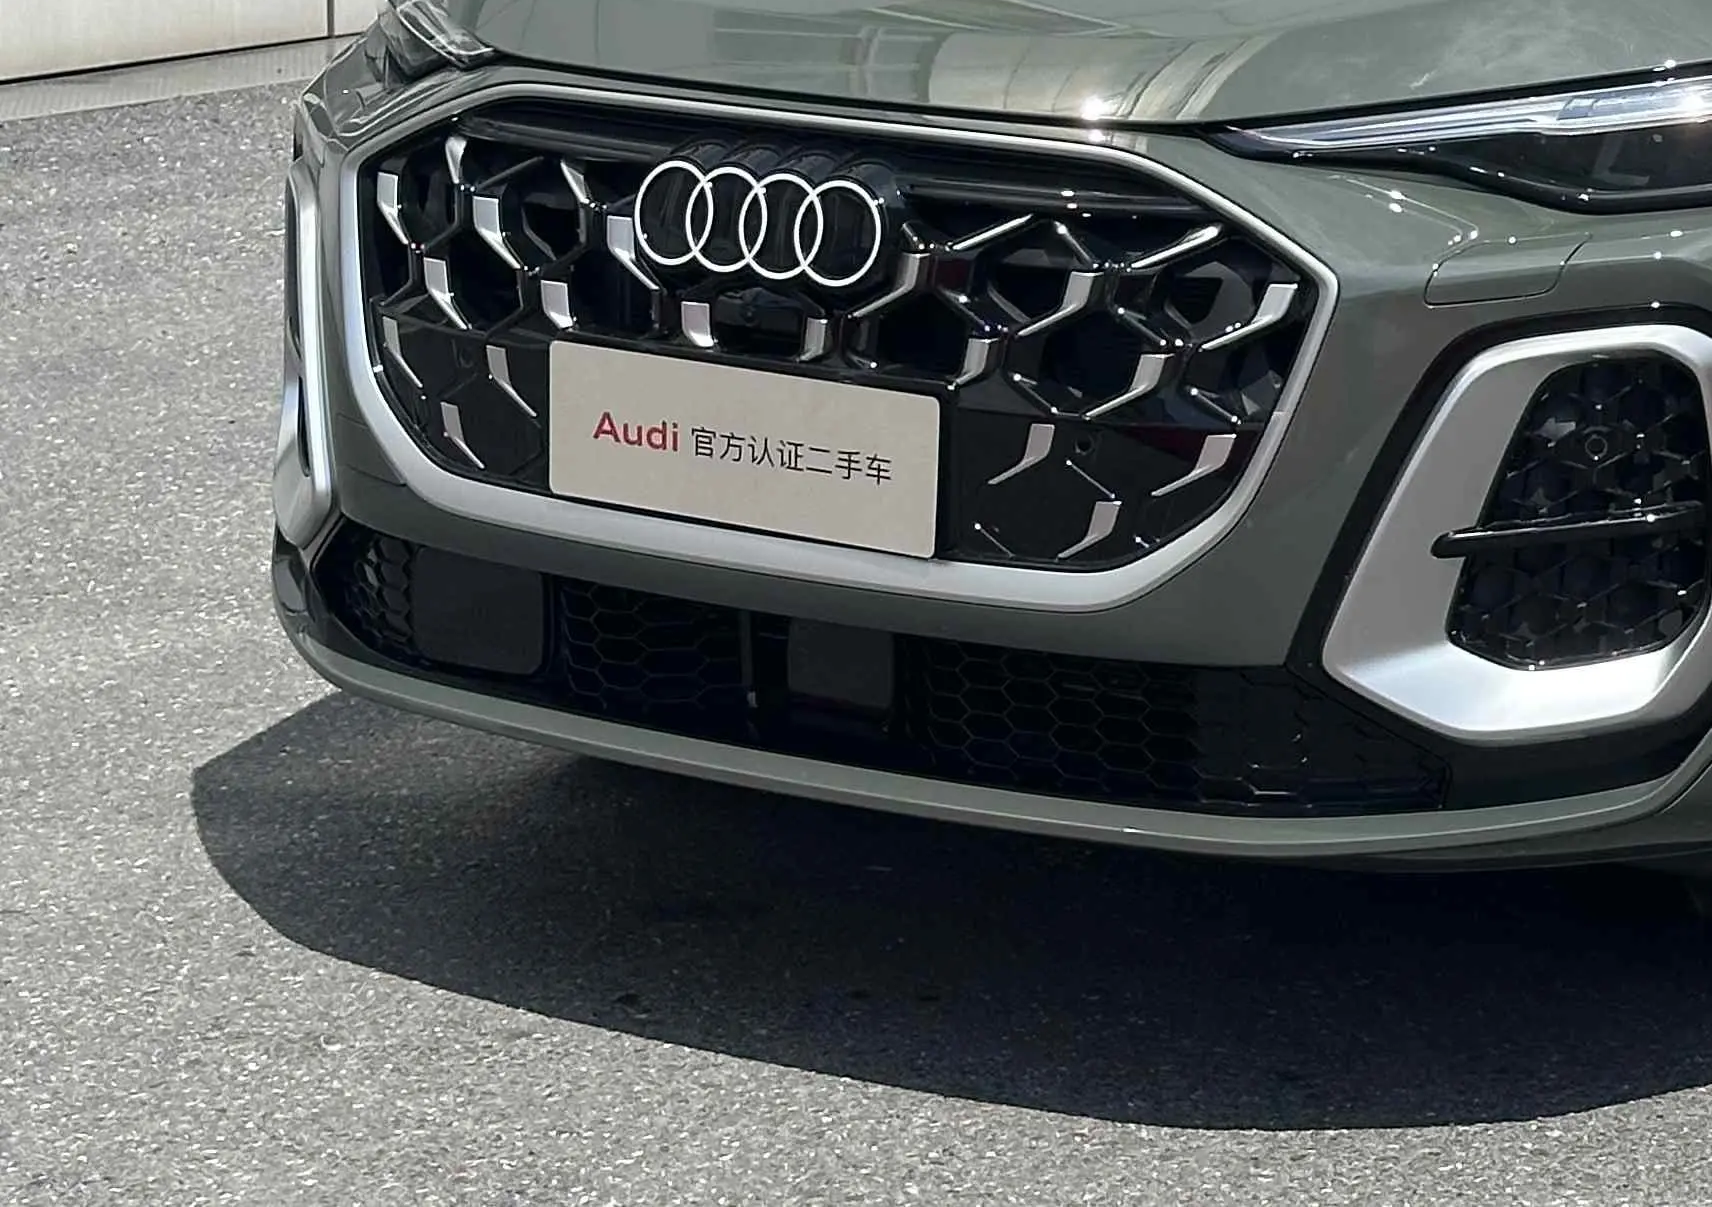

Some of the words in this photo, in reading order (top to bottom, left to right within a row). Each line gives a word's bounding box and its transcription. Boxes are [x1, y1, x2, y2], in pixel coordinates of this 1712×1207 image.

[592, 411, 679, 452] Audi
[691, 427, 893, 486] 官方认证二手车
